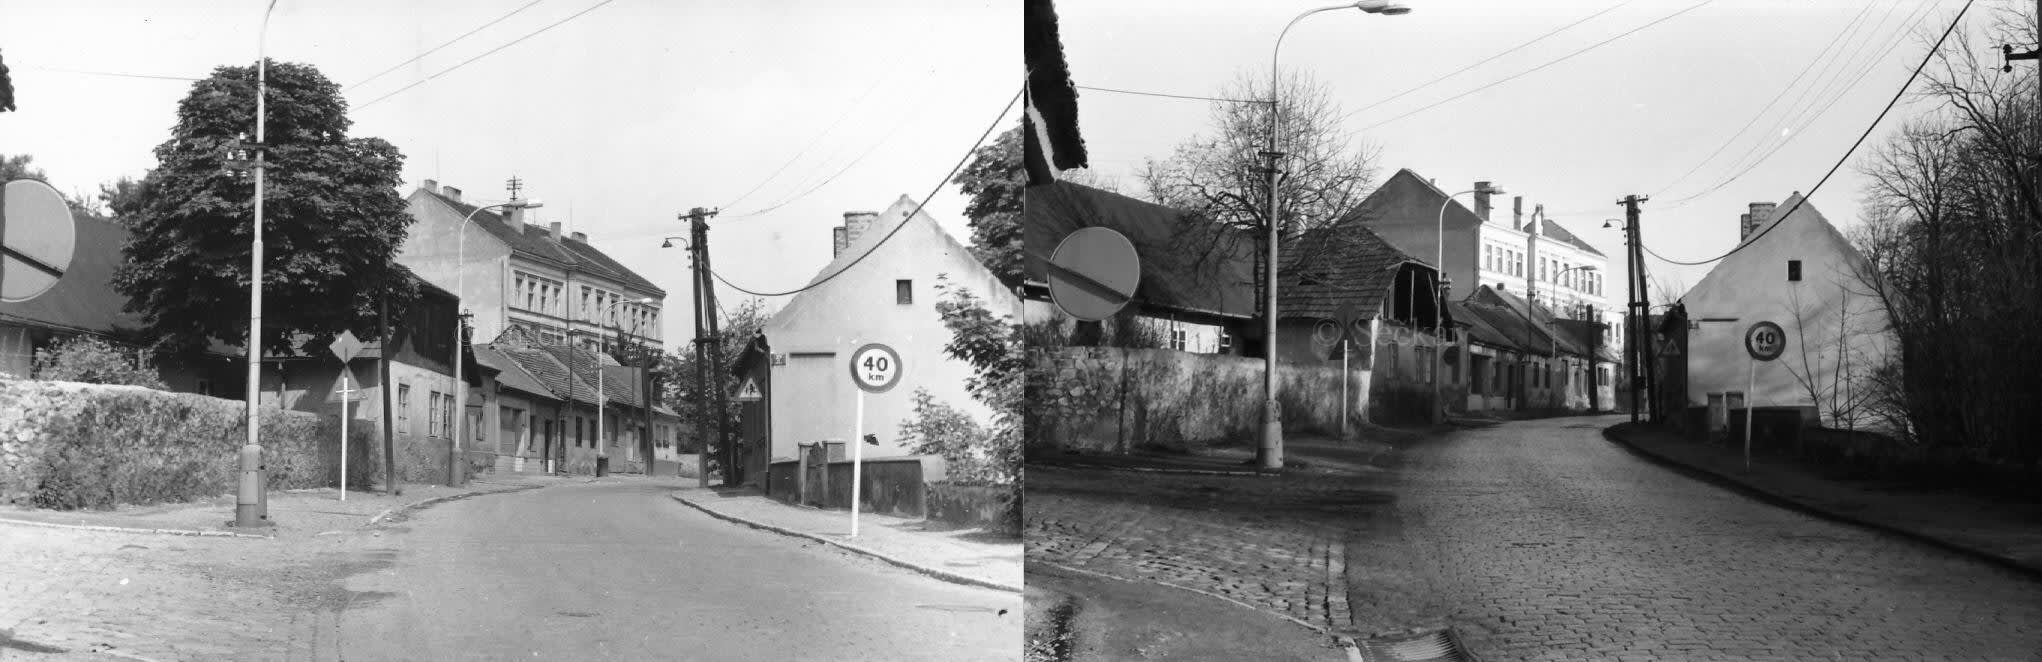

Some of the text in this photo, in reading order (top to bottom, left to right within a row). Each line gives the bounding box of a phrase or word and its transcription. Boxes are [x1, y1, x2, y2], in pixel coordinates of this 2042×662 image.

[1756, 331, 1775, 345] 40
[863, 356, 888, 372] 40
[868, 372, 885, 381] km
